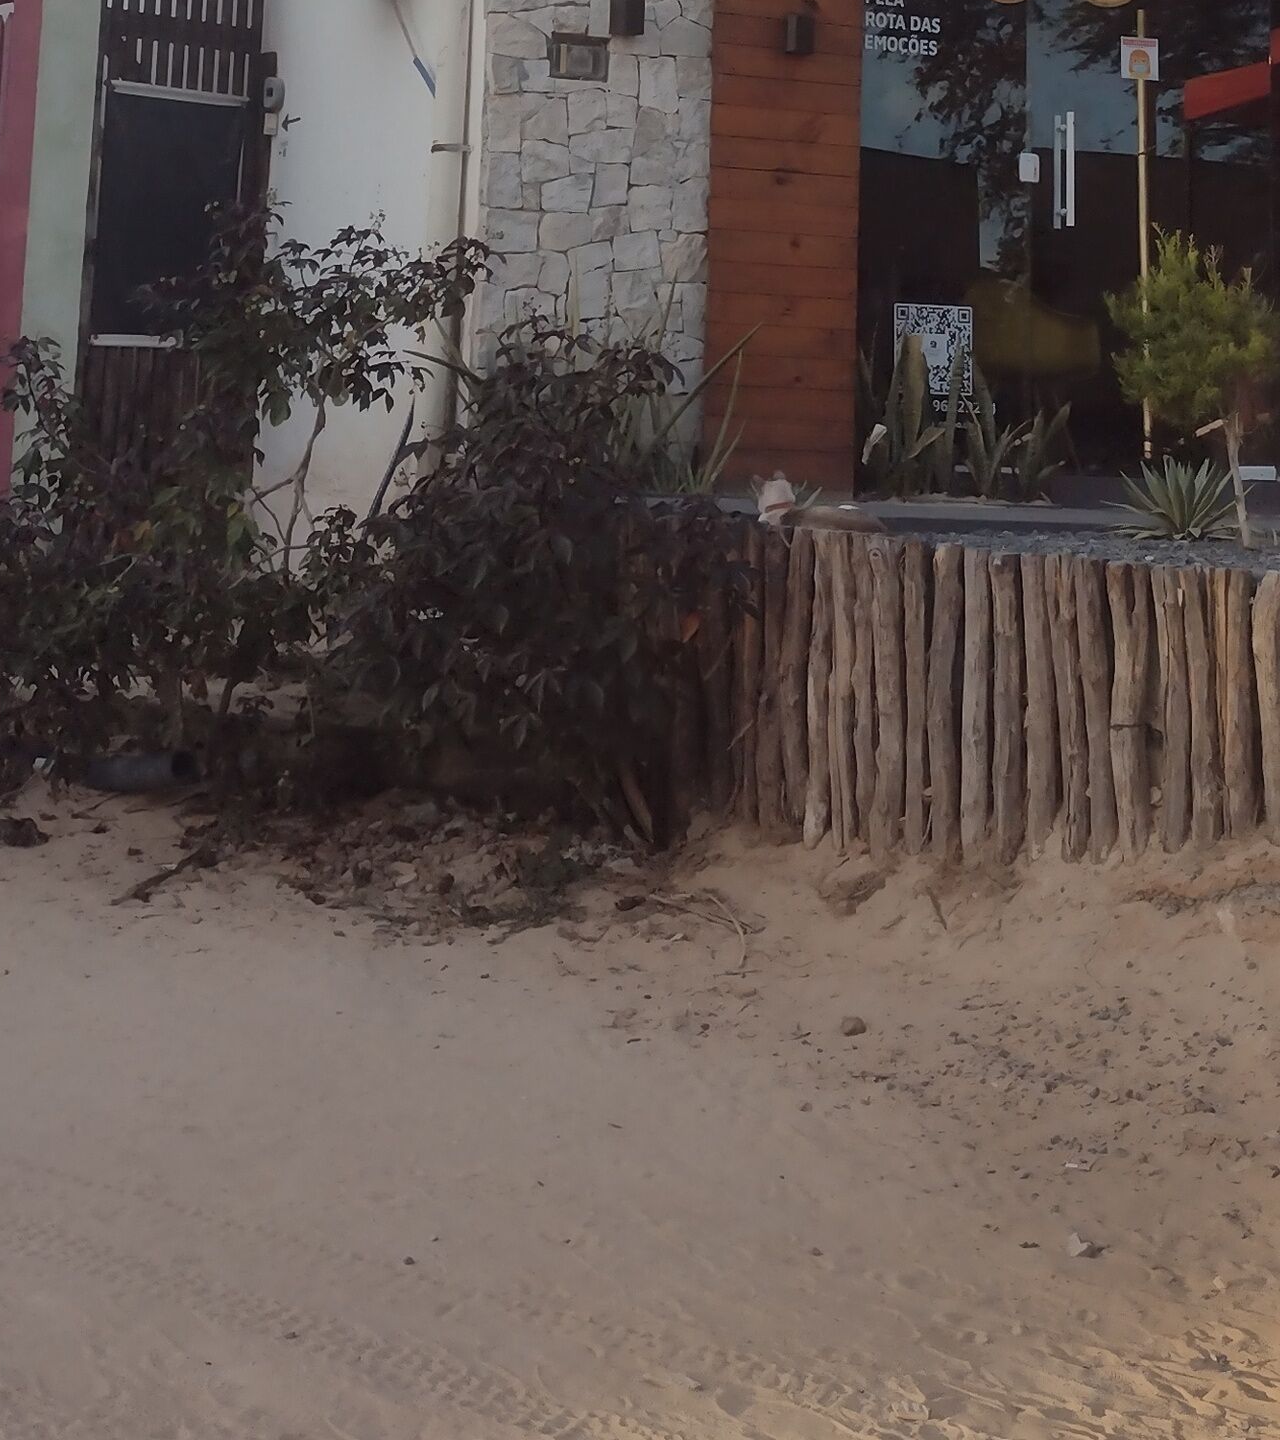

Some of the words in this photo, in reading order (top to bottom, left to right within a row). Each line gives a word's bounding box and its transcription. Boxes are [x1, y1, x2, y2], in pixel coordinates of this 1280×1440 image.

[864, 11, 907, 31] ROTA
[910, 15, 941, 34] DAS
[864, 35, 938, 57] EMOÇÕES
